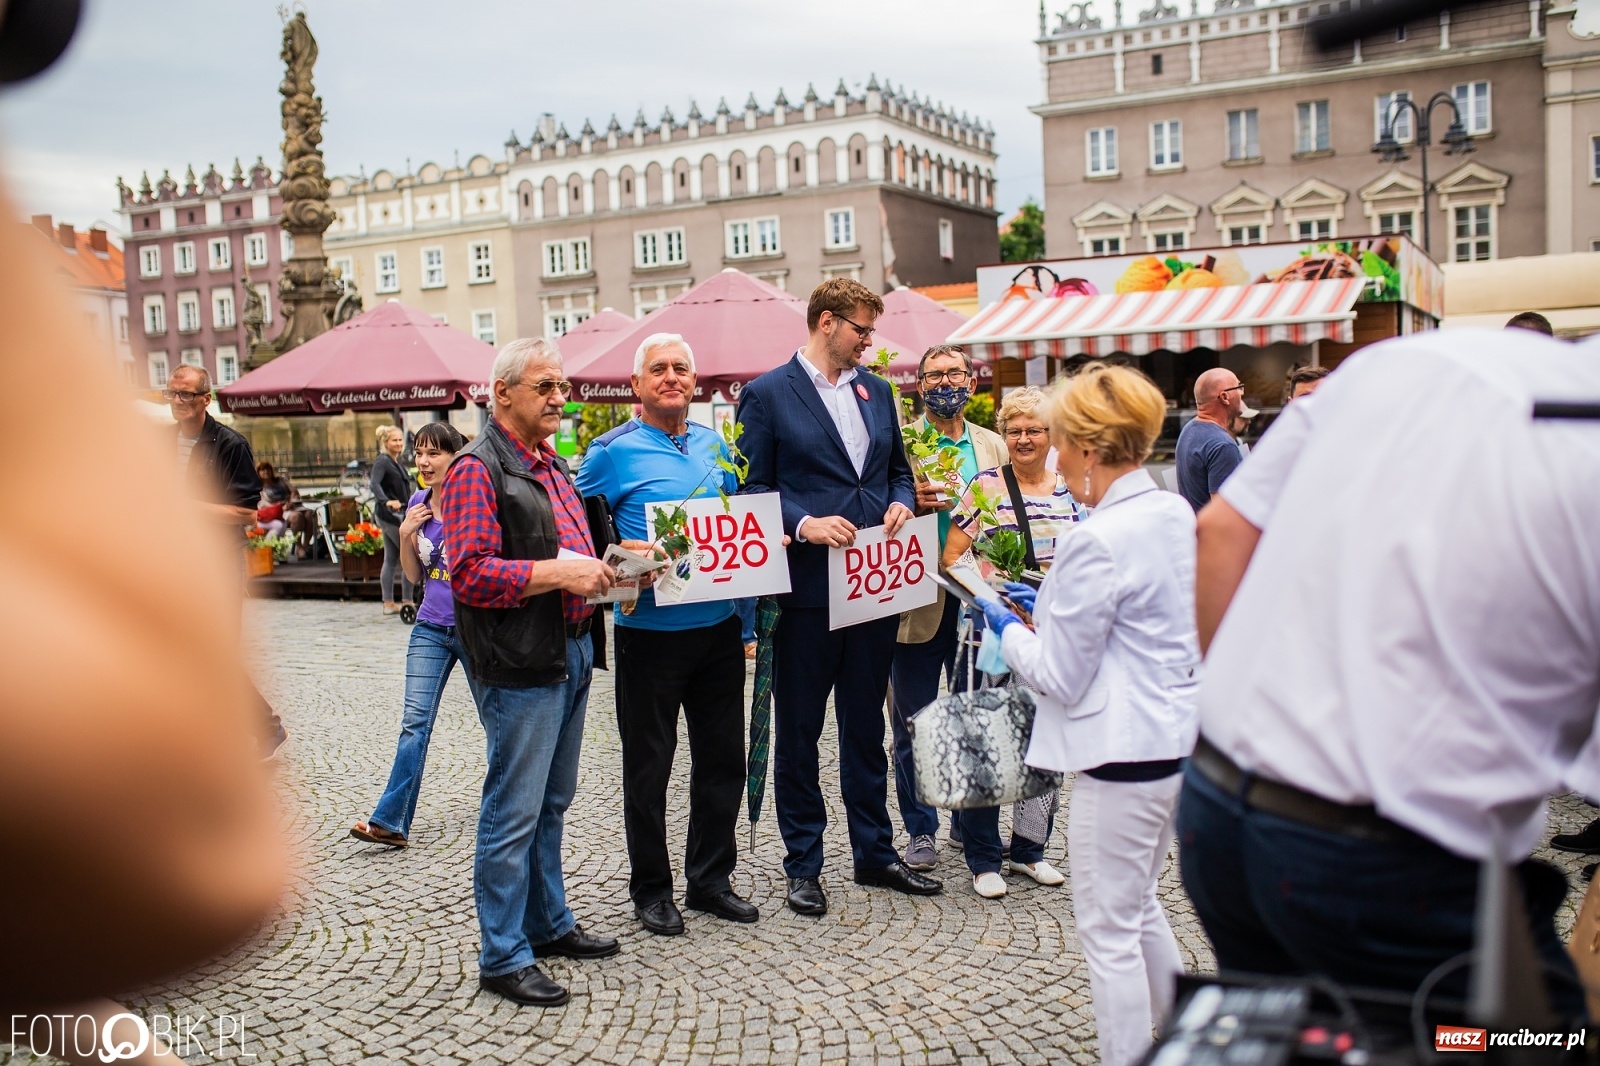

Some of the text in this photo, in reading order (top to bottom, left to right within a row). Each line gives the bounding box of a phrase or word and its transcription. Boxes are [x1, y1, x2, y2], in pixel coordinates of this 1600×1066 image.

[226, 392, 305, 411] Gelateria Ciao Italia
[321, 384, 447, 408] Gelateria Ciao Italia
[580, 382, 633, 401] Gelateria
[674, 539, 769, 573] 020
[845, 534, 924, 576] DUDA
[847, 559, 926, 601] 2020
